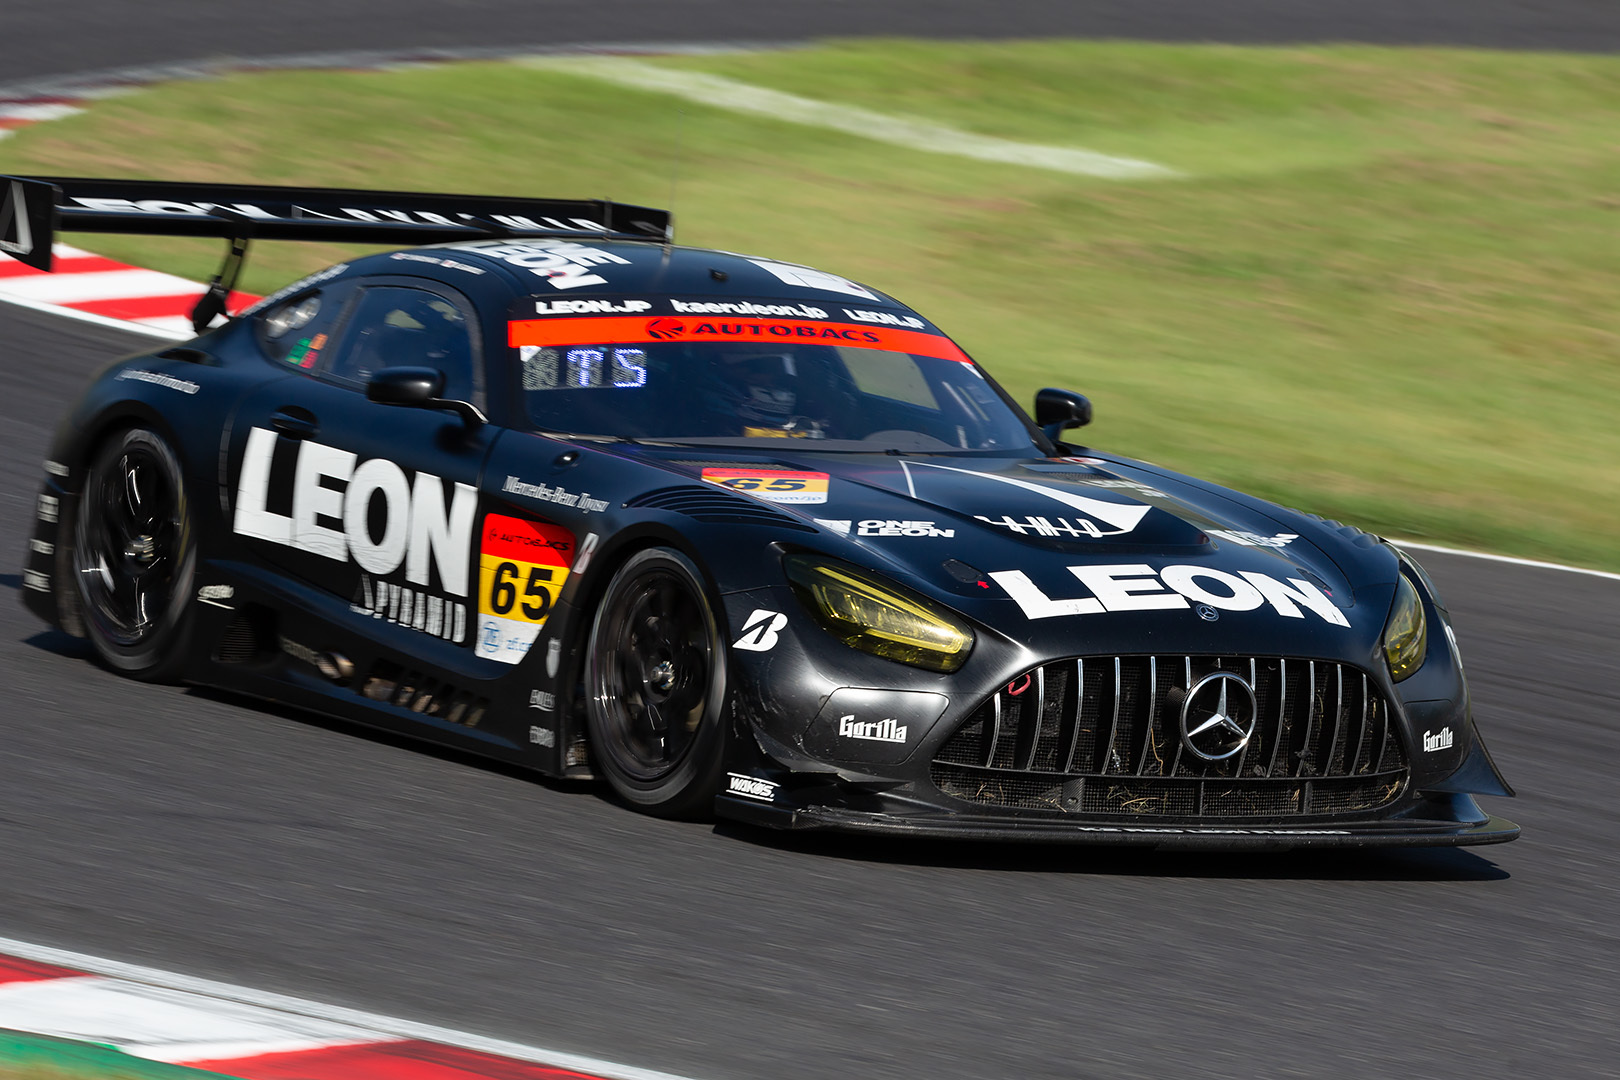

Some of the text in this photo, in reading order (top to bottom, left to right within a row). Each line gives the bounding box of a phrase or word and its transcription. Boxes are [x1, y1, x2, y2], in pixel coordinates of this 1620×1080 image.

[535, 298, 926, 330] LEON.JP kaeruleon.jp LEON.JP
[695, 323, 881, 344] AUTOBACS
[721, 477, 807, 491] 65
[234, 426, 479, 601] LEON
[857, 519, 935, 529] ONE
[500, 532, 571, 551] AUTOBACS
[857, 526, 955, 538] LEON
[490, 561, 552, 621] 65
[987, 563, 1352, 629] LEON
[839, 714, 908, 744] Gorilla
[1423, 726, 1454, 753] Gorilla
